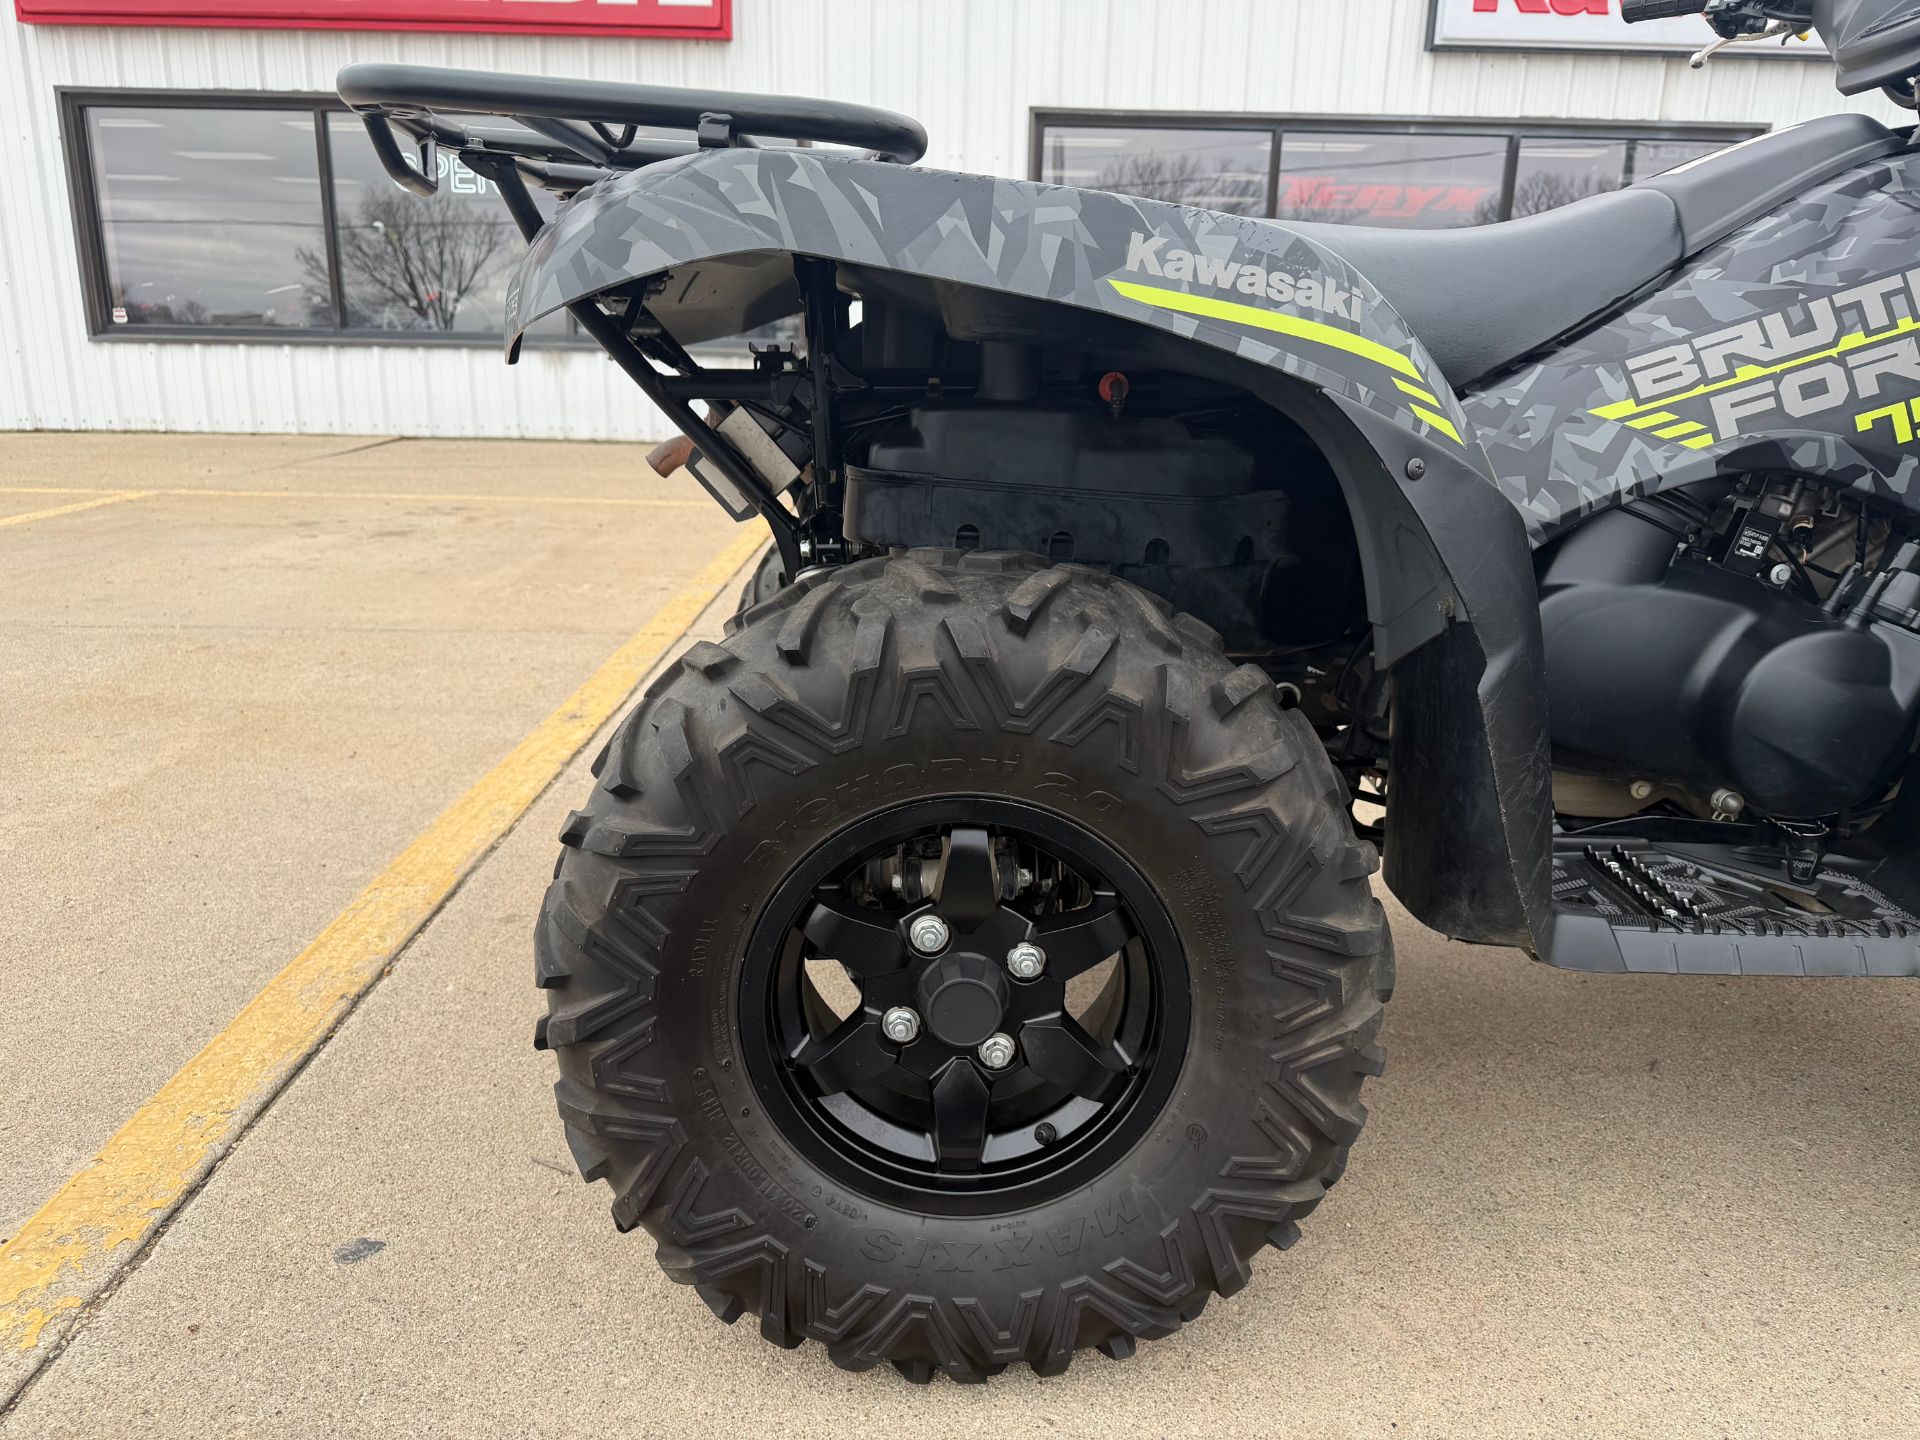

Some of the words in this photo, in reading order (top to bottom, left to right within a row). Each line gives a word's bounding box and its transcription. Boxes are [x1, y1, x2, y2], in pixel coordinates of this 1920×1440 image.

[1125, 231, 1362, 323] Kawasaki
[1624, 267, 1920, 399] BRUT
[859, 1194, 1141, 1272] MAXXIS
